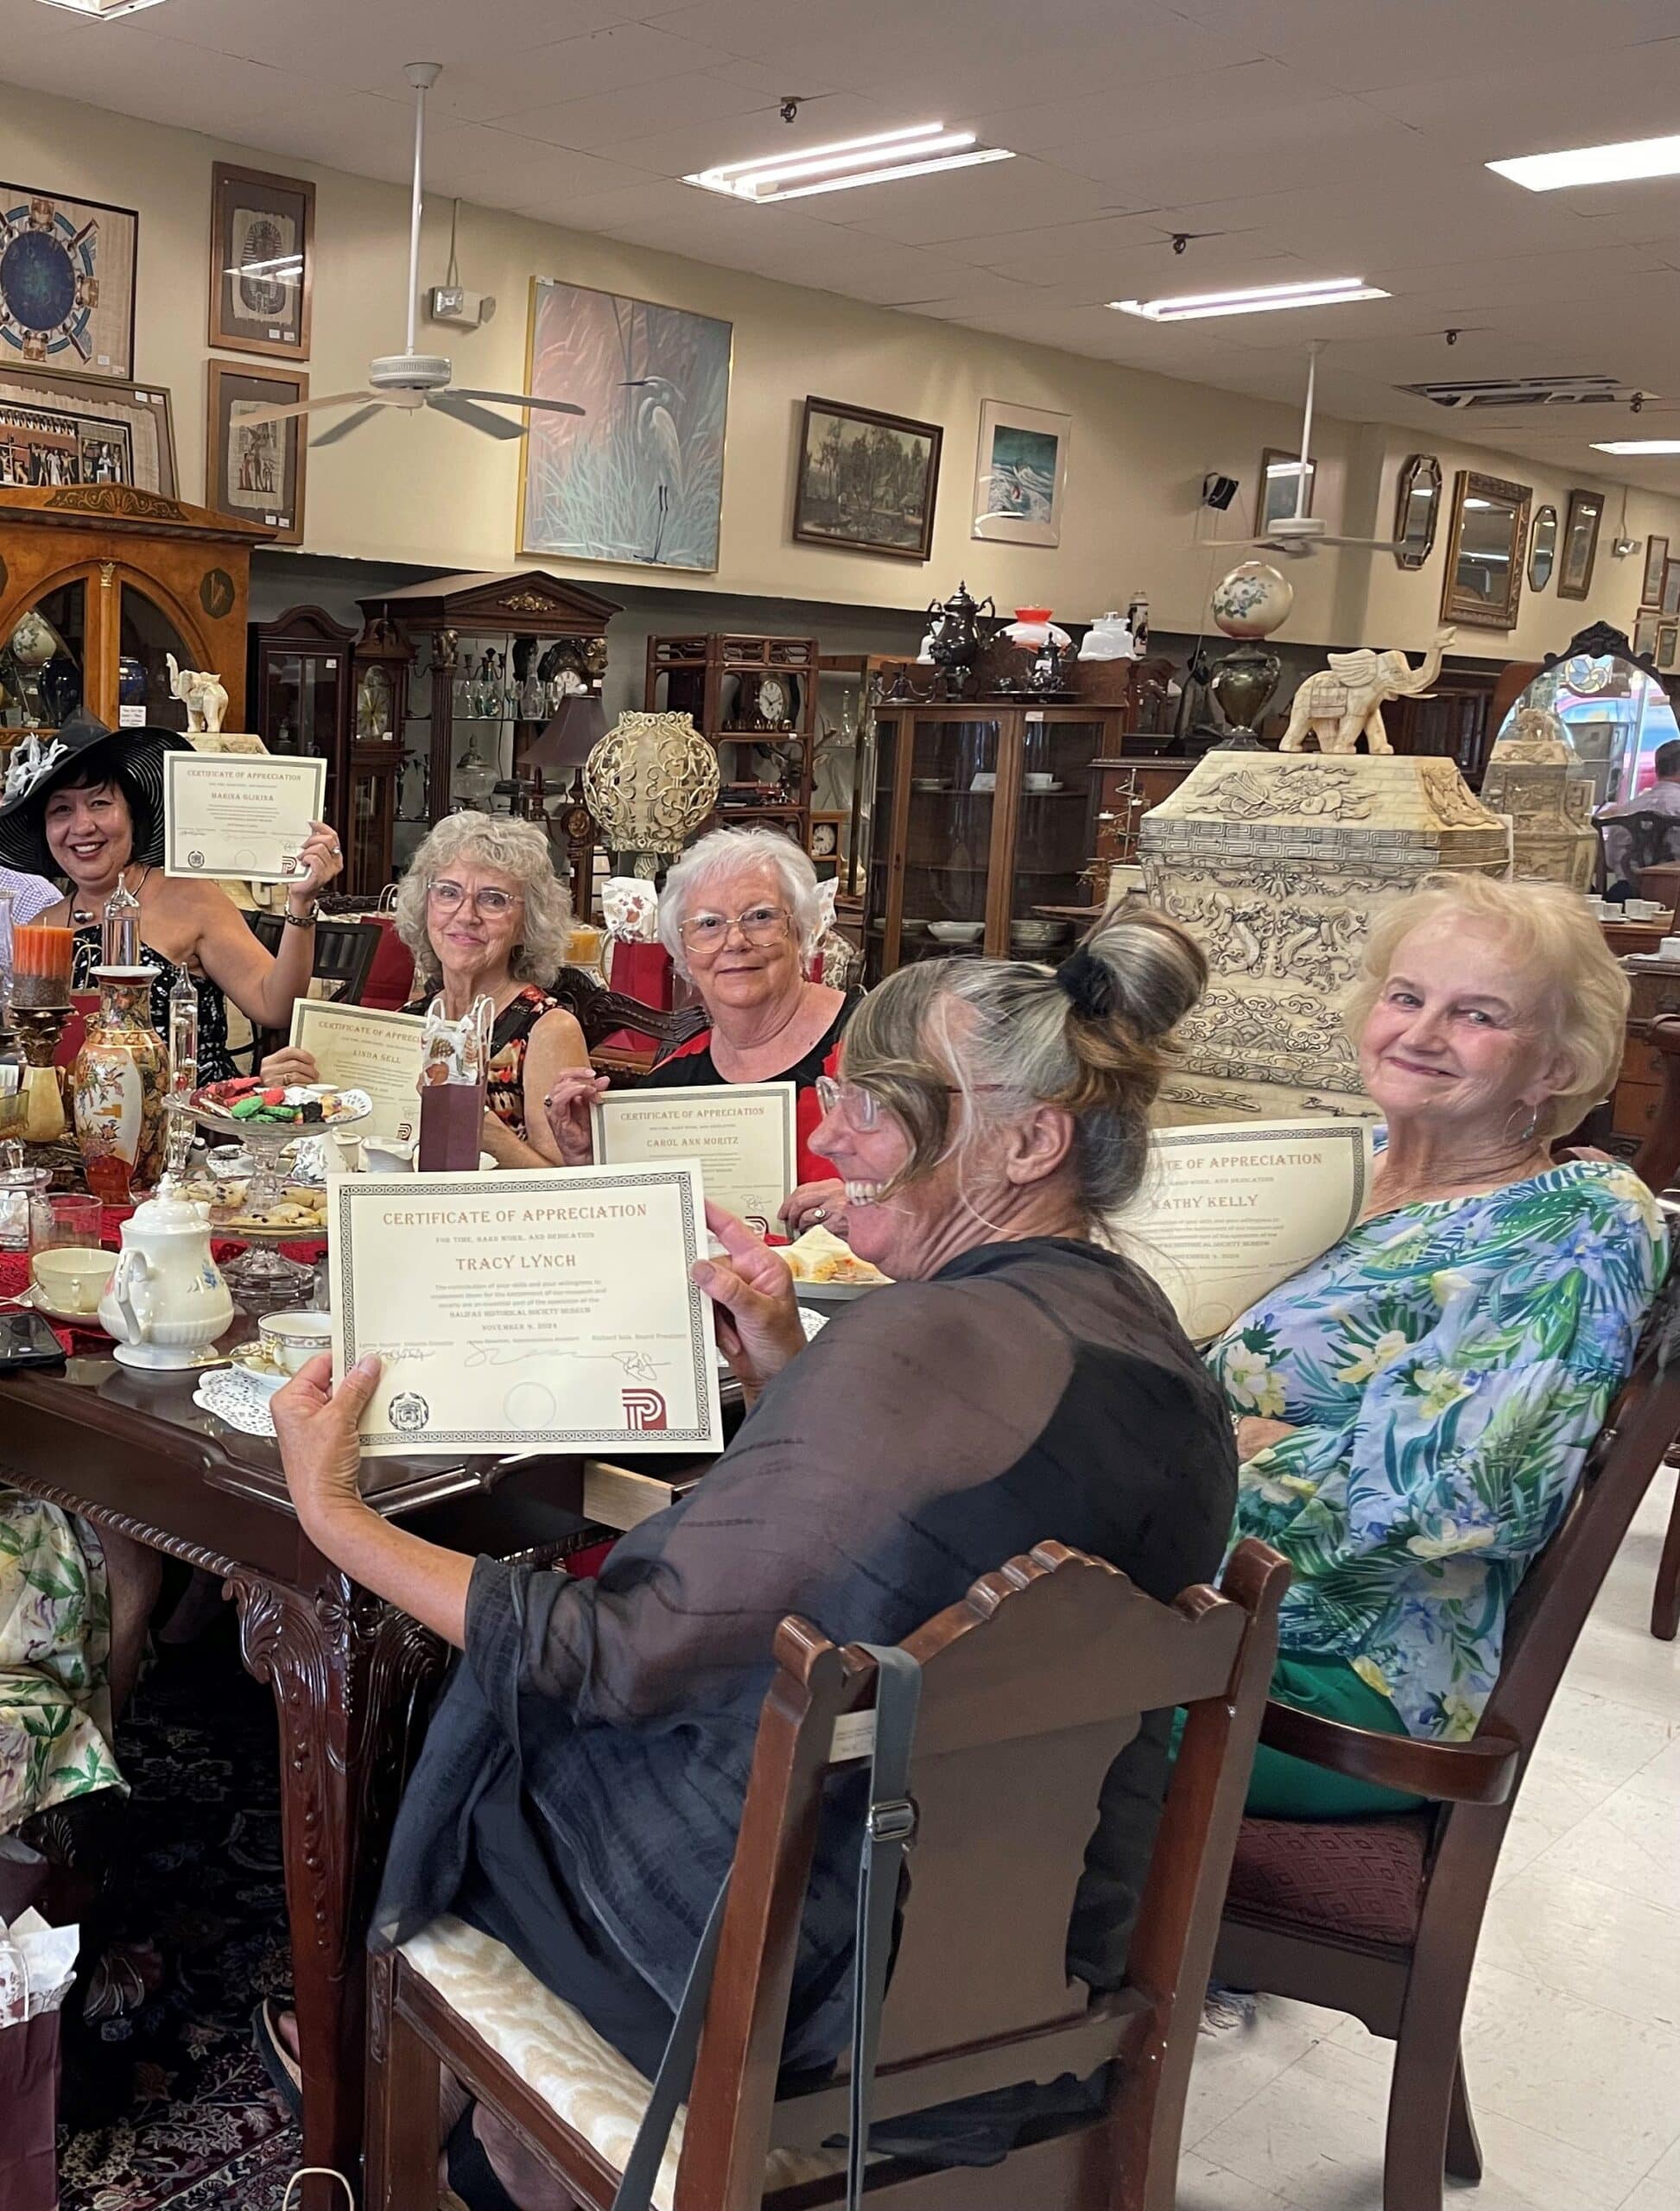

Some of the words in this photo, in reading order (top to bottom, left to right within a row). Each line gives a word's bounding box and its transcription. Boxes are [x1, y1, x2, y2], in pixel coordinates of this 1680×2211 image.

[620, 1111, 680, 1120] CERTIFICATE
[1186, 1158, 1205, 1169] OF
[1209, 1153, 1322, 1169] APPRECIATION
[1208, 1194, 1258, 1207] KELLY
[383, 1211, 491, 1226] CERTIFICATE
[496, 1210, 517, 1223] OF
[523, 1203, 647, 1221] APPRECIATION
[456, 1254, 516, 1270] TRACY
[521, 1253, 576, 1269] LYNCH
